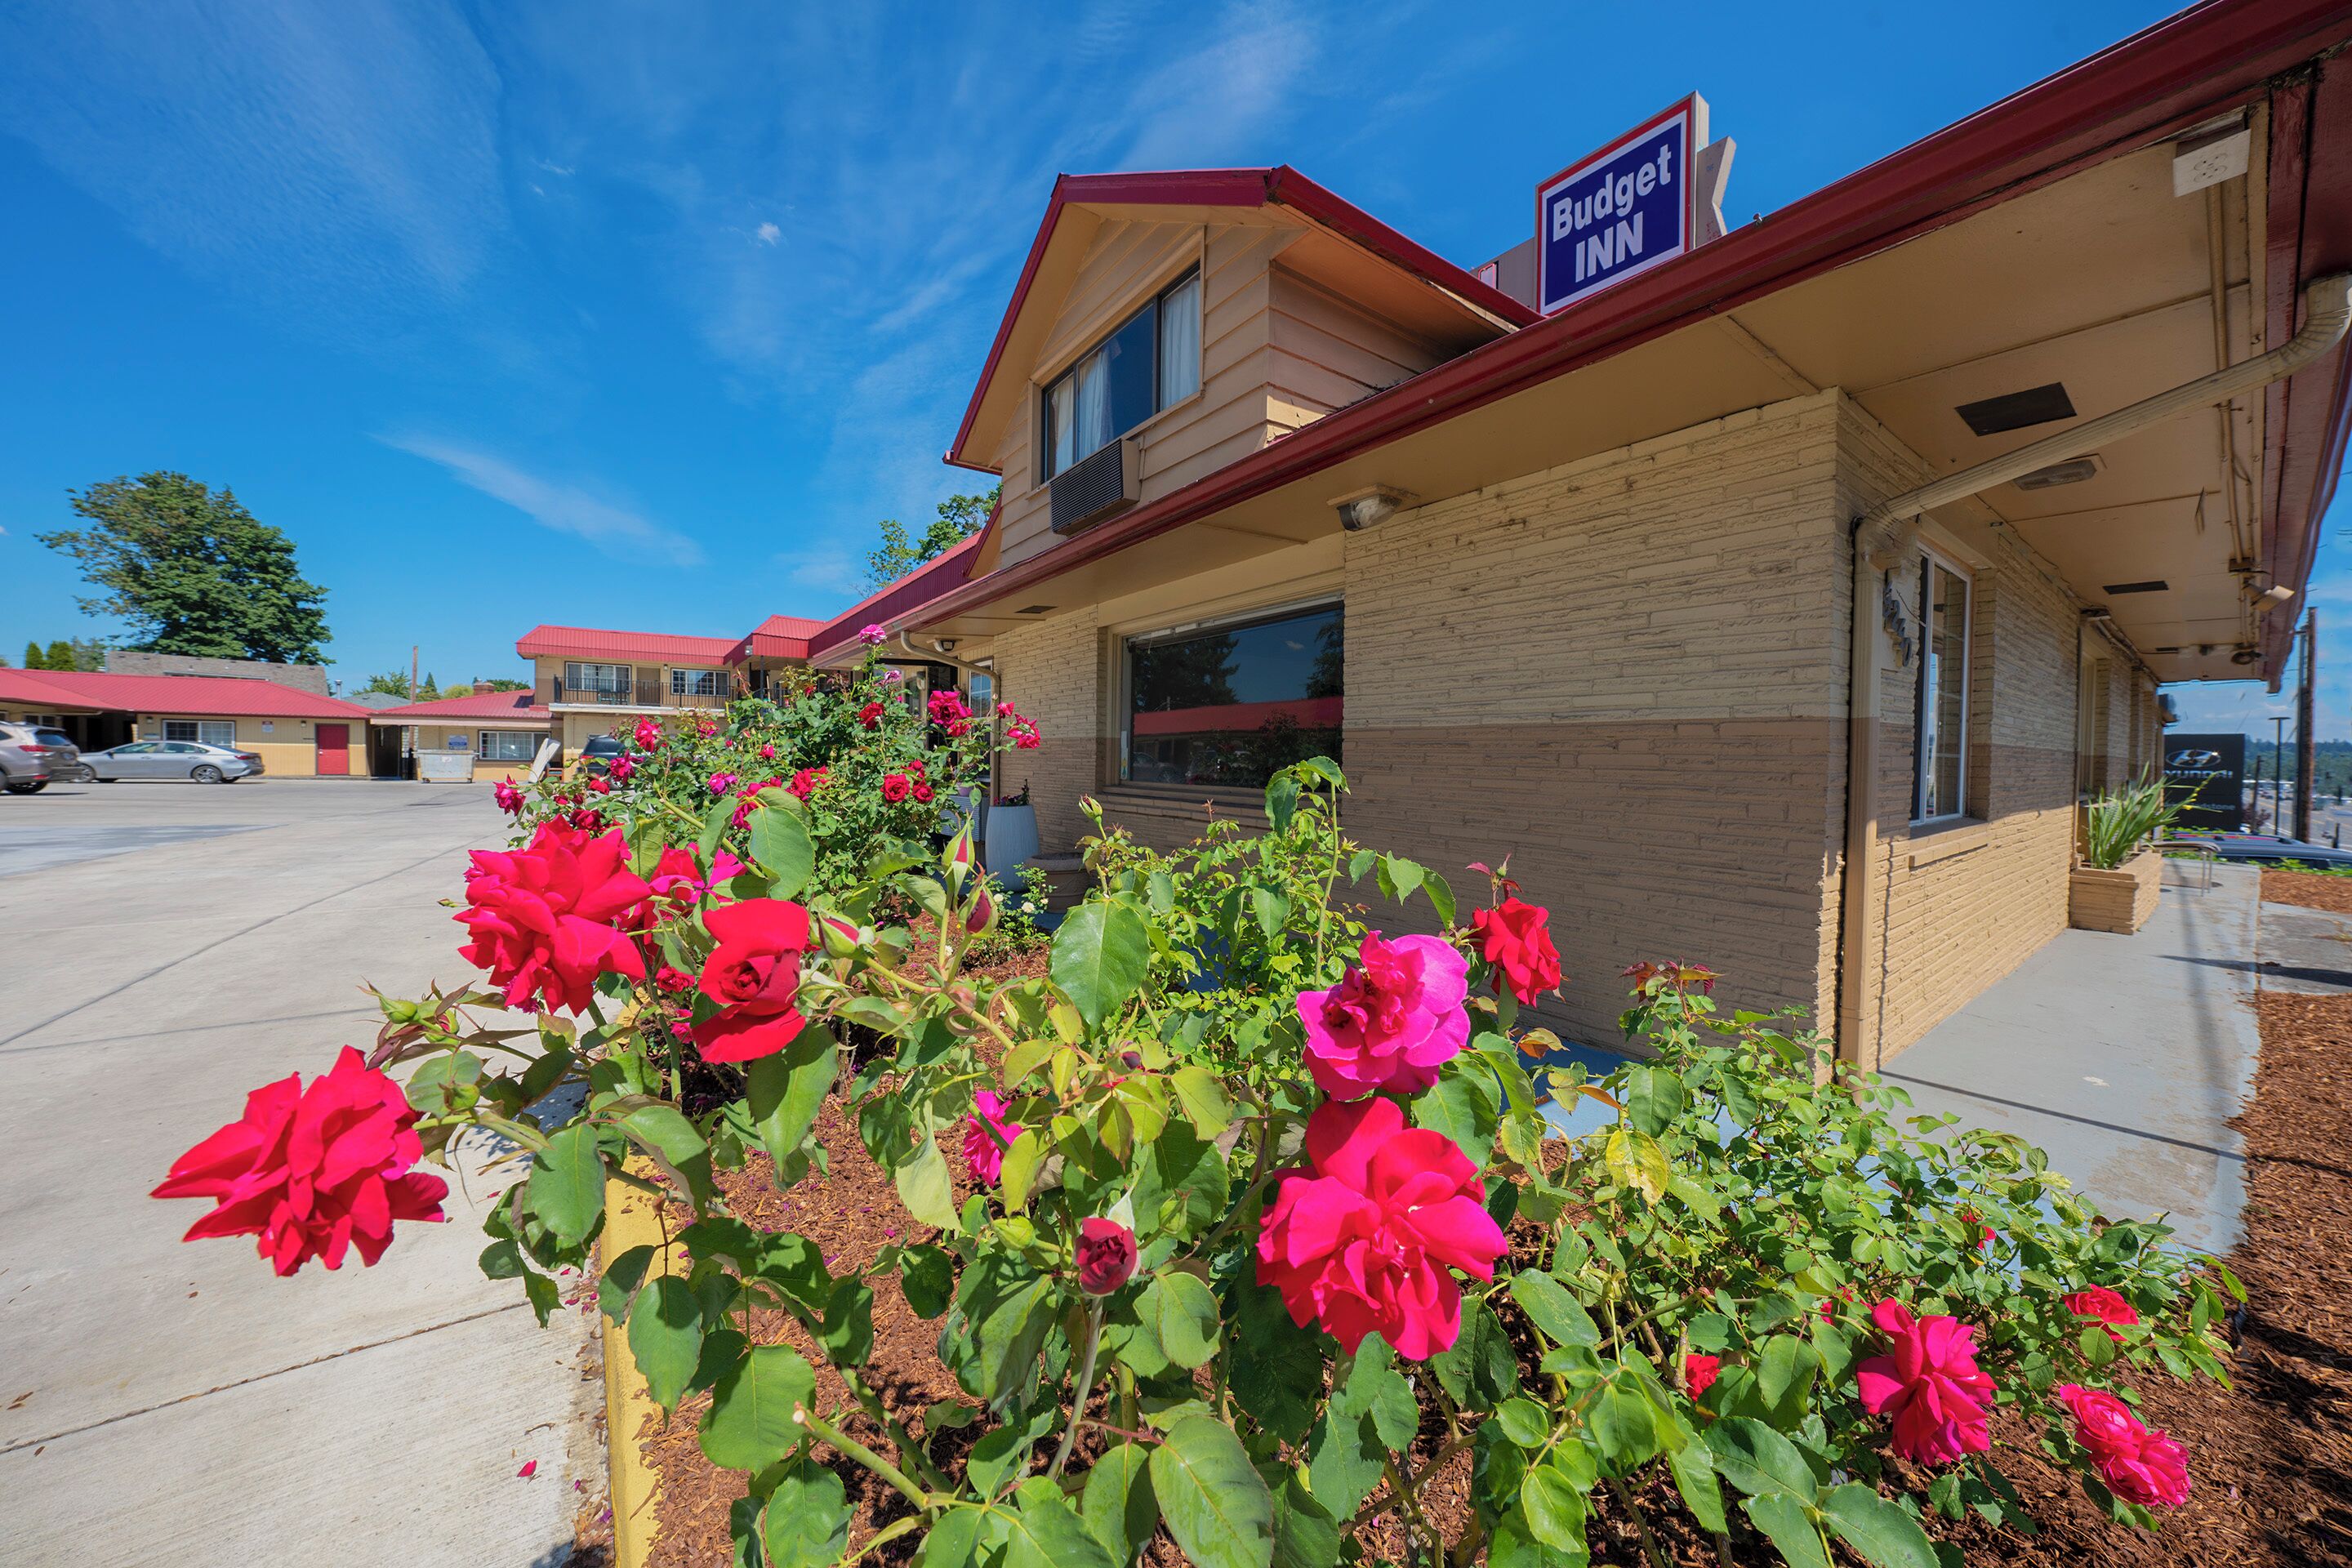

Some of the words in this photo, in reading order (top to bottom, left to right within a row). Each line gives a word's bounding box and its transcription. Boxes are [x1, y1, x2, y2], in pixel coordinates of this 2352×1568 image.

[1553, 144, 1672, 243] Budget
[1575, 211, 1643, 283] INN
[2162, 769, 2234, 779] YUNDAI
